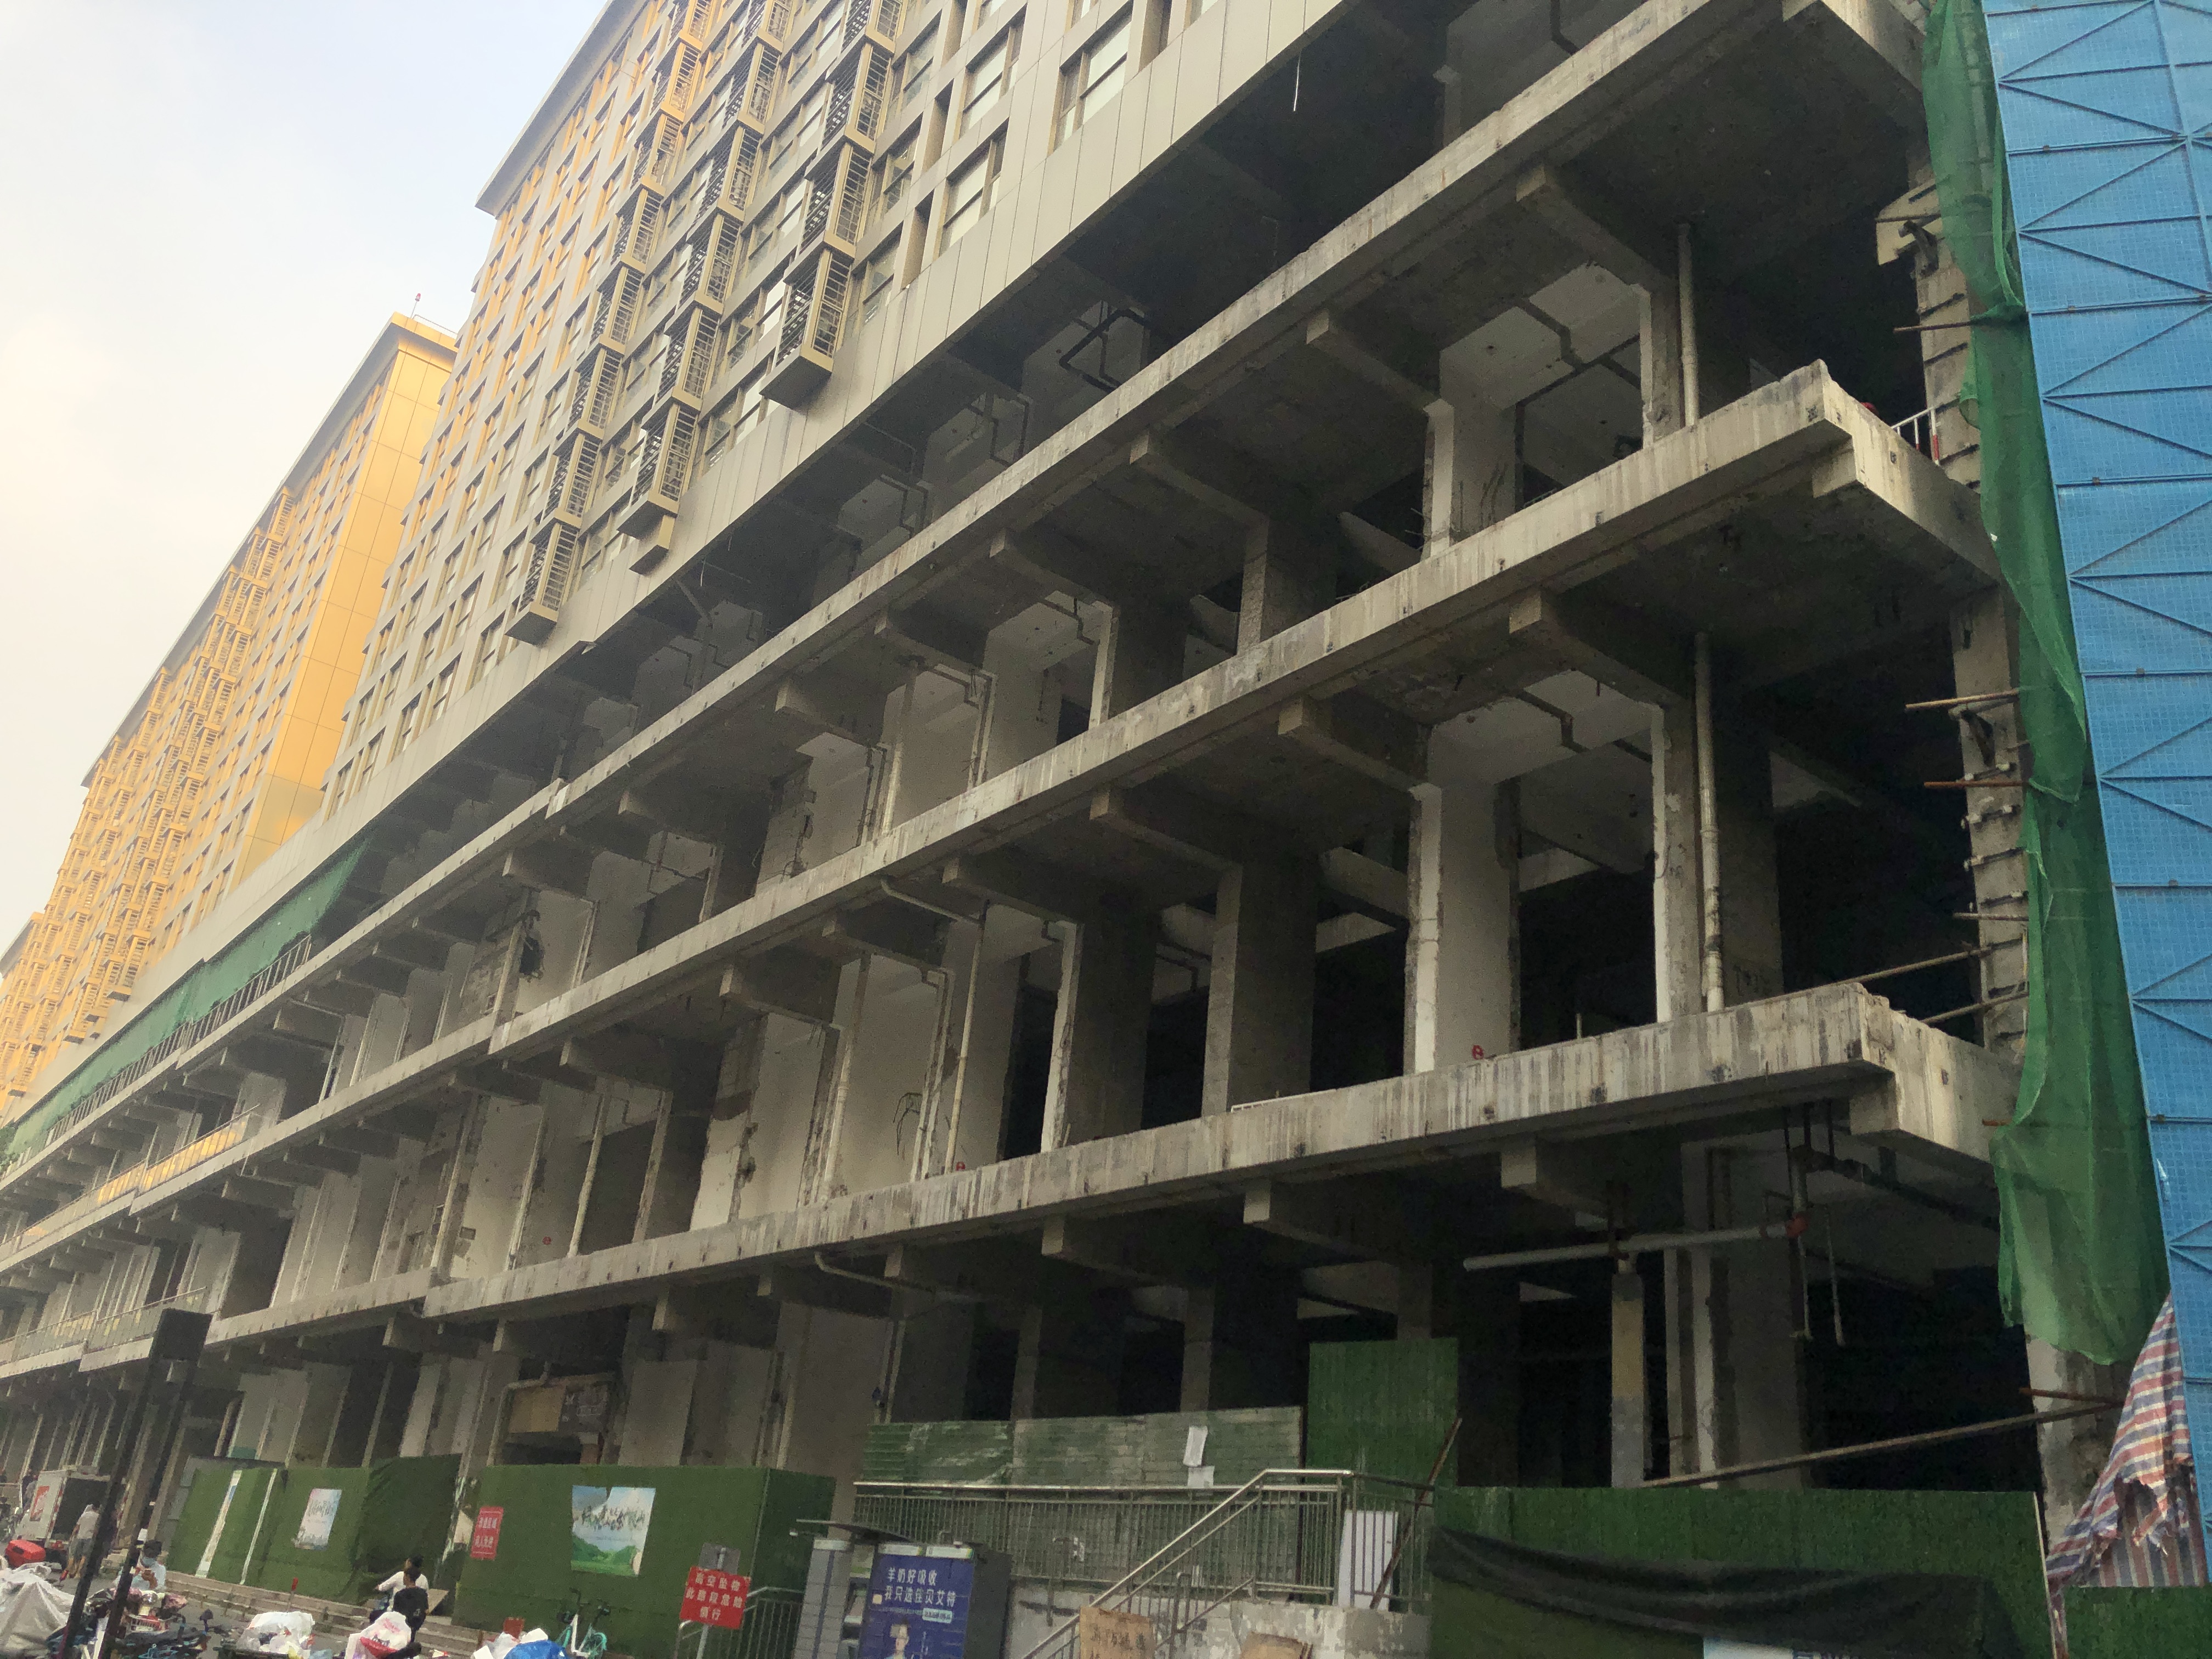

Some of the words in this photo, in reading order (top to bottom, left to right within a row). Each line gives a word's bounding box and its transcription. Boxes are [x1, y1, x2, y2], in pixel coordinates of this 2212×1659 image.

[695, 1572, 740, 1592] 高空坠物
[888, 1567, 938, 1586] 羊奶好吸收
[685, 1587, 743, 1609] 此路段危险
[884, 1585, 956, 1607] 我只选佳贝艾特
